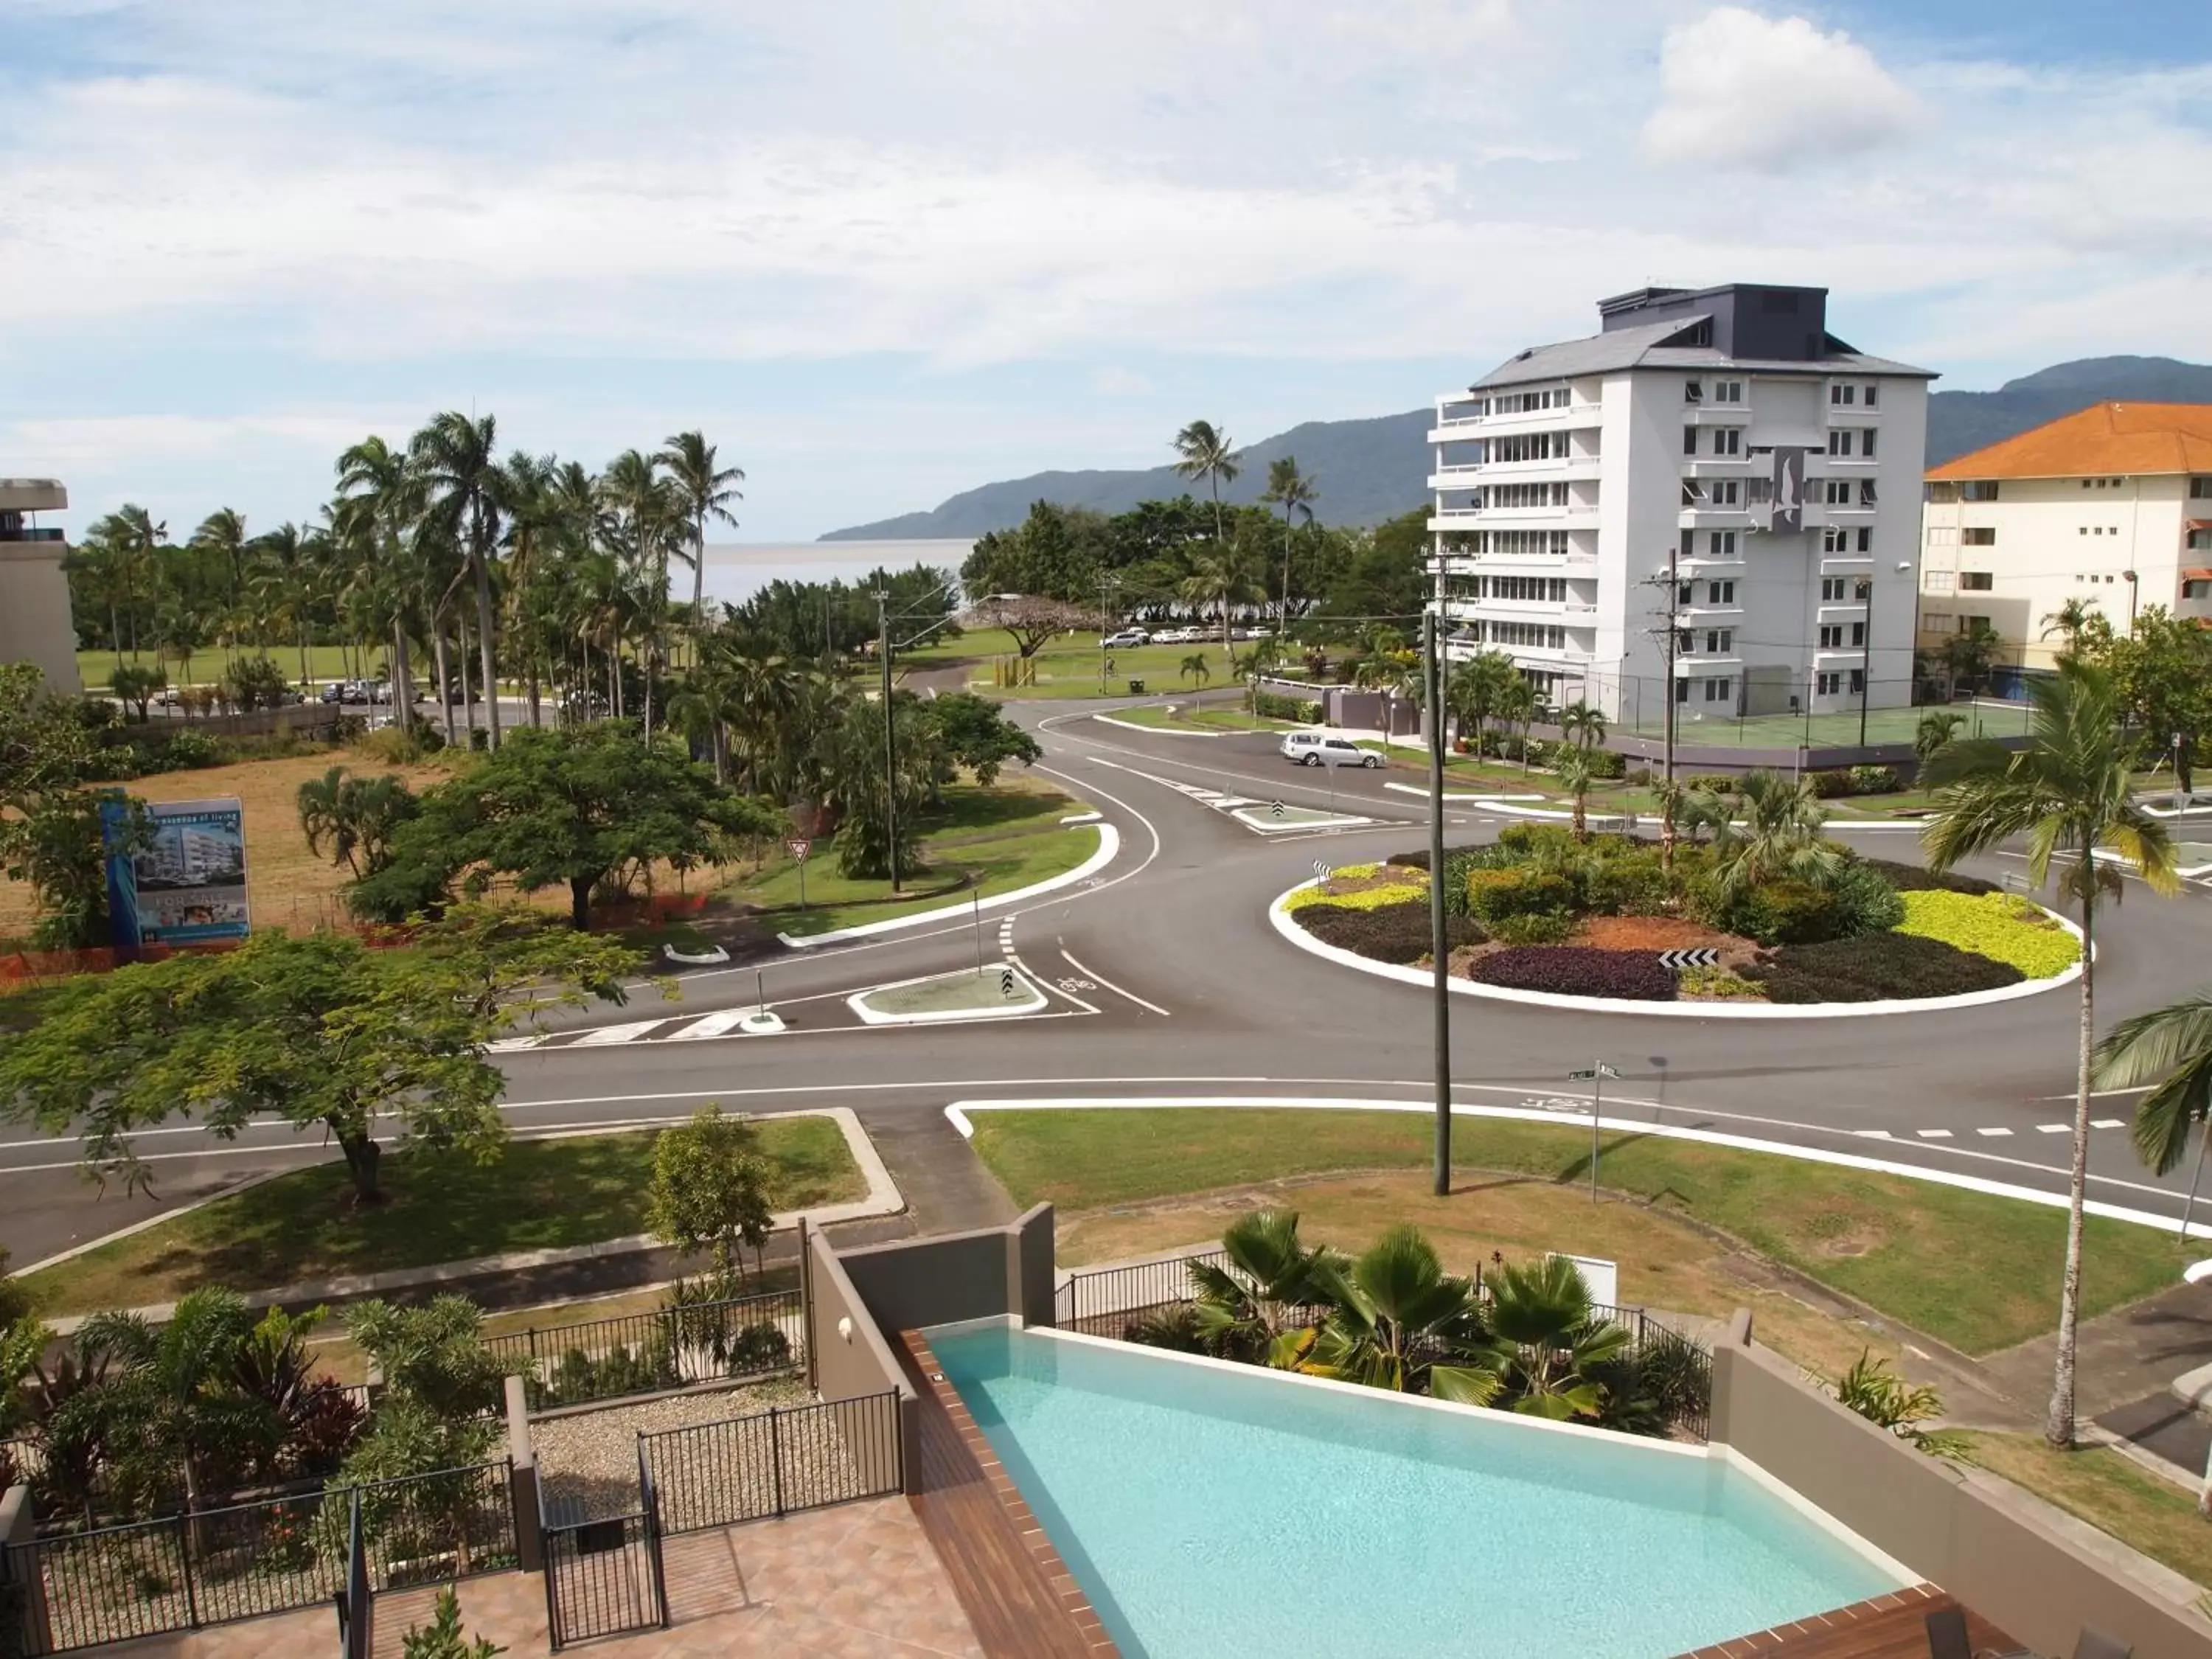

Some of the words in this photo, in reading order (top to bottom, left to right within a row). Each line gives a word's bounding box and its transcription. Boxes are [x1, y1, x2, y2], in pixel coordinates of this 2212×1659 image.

[212, 813, 237, 821] living
[154, 895, 185, 907] FOR
[189, 891, 224, 903] SALE
